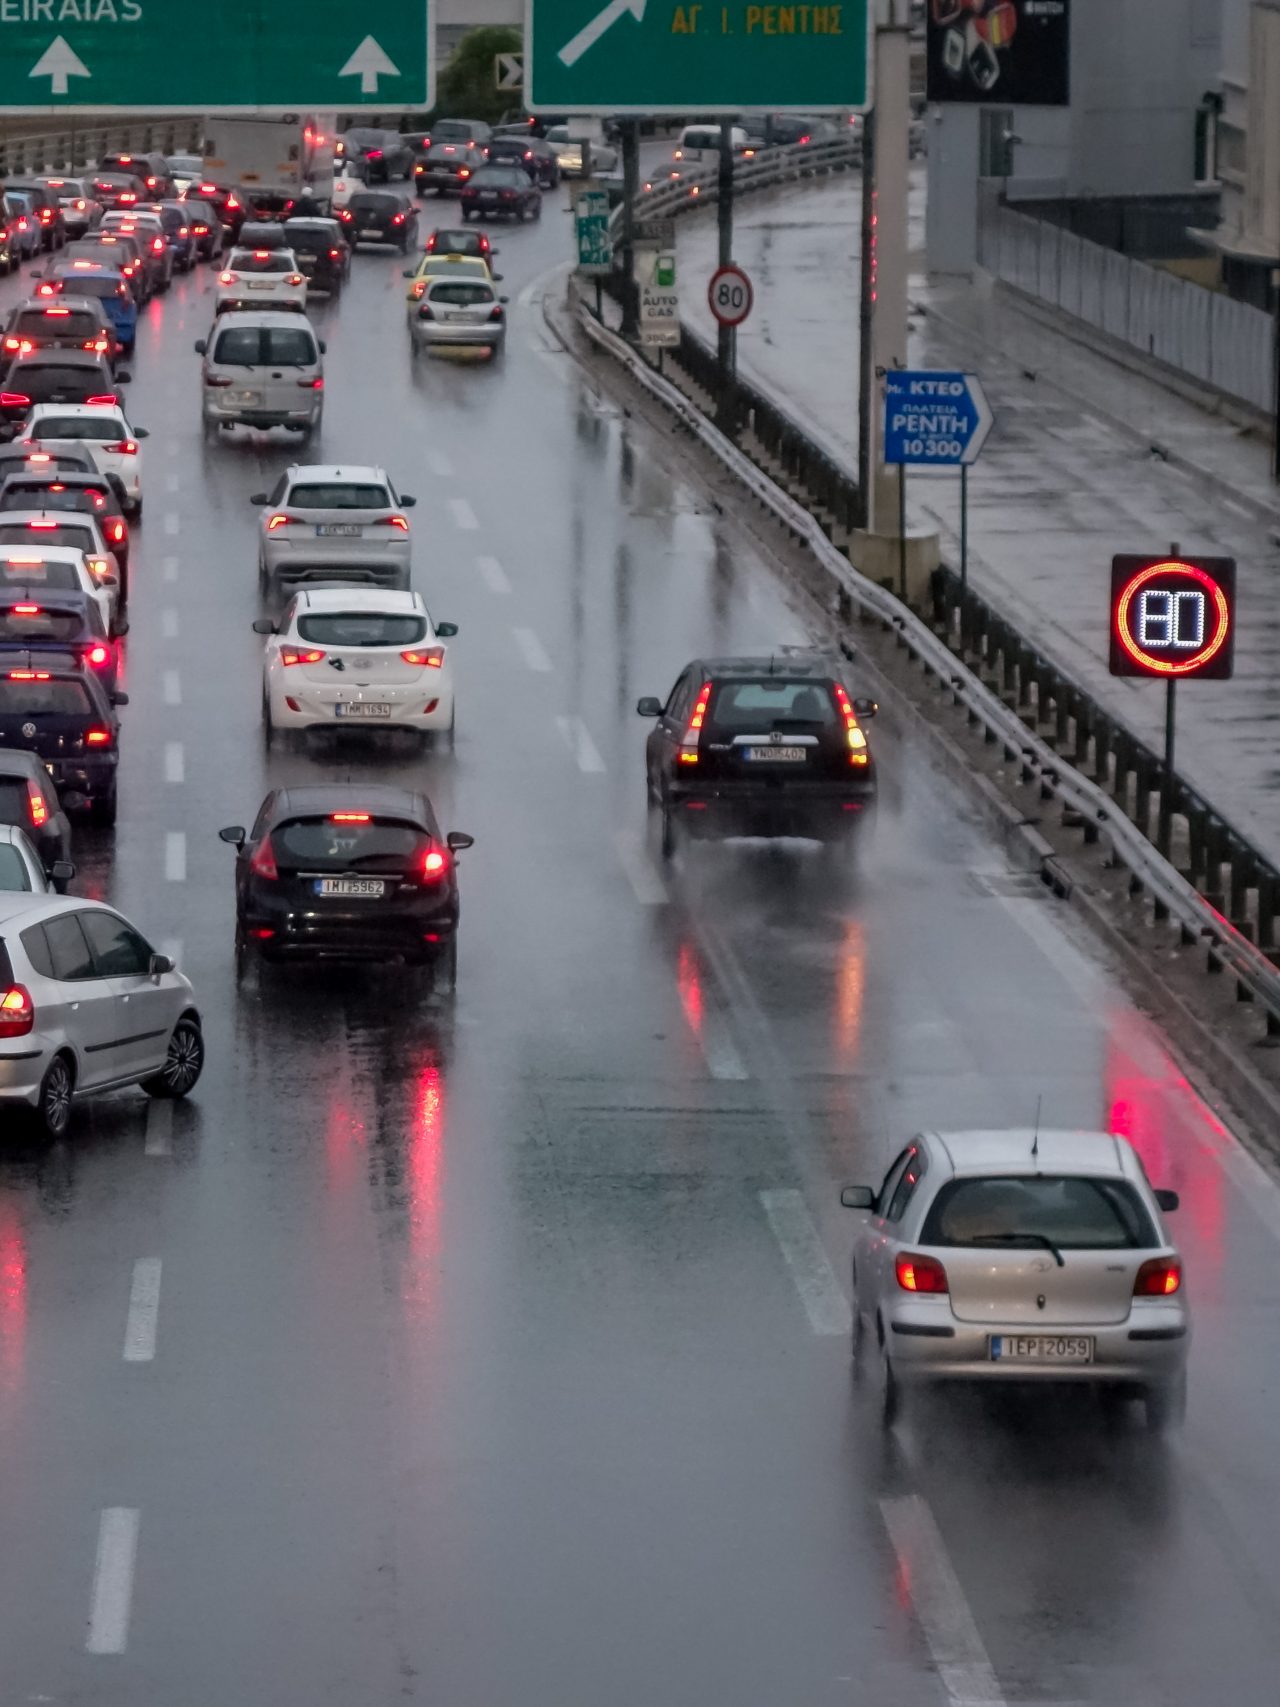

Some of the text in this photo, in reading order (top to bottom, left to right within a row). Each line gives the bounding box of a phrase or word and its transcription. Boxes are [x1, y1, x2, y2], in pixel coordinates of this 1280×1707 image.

[746, 5, 842, 34] ΡΕΝΤΗΣ
[642, 296, 678, 306] AUTO
[718, 283, 743, 308] 80
[647, 307, 674, 317] GAS
[892, 414, 969, 433] ΡΕΝΤΗ
[1139, 590, 1205, 648] 80
